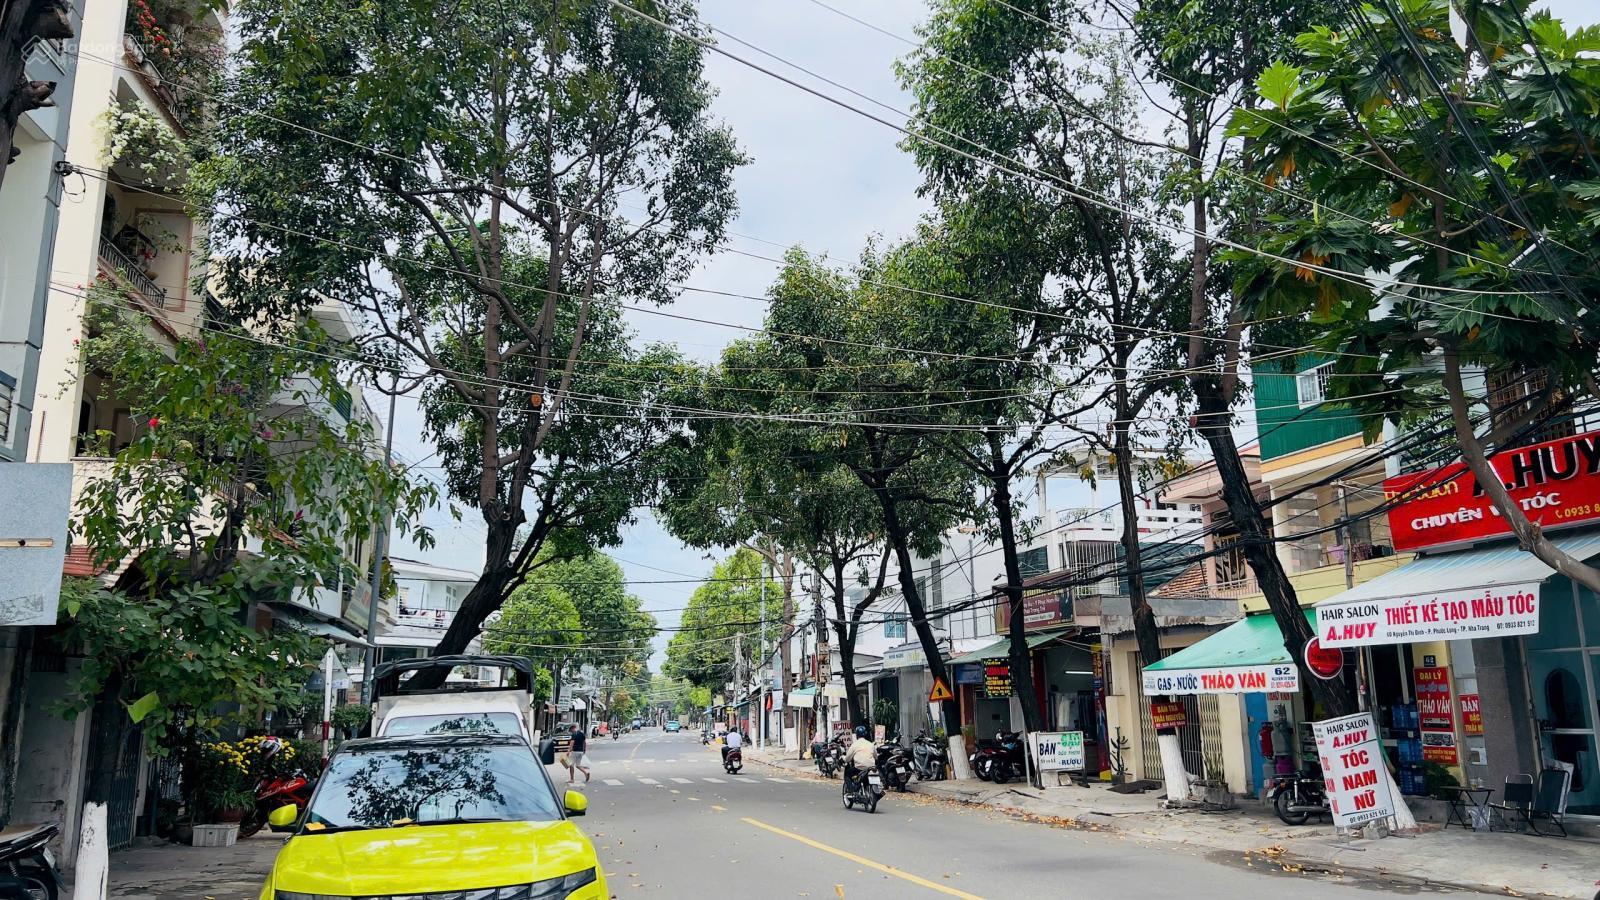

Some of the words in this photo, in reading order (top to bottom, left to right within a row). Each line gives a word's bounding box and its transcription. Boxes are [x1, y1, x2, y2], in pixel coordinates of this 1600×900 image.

[1411, 507, 1483, 530] CHUYÊN
[1519, 491, 1561, 511] TÓC
[1565, 505, 1591, 517] 0933
[1321, 608, 1344, 620] HAIR
[1346, 605, 1379, 619] SALON
[1385, 600, 1418, 625] THIẾT
[1421, 597, 1439, 622] KẾ
[1441, 600, 1468, 624] TẠO
[1471, 590, 1504, 618] MẪU
[1507, 590, 1535, 615] TÓC
[1326, 622, 1377, 641] A.HUY
[1157, 677, 1171, 691] GAS
[1201, 670, 1235, 689] THẢO
[1274, 667, 1290, 675] 62
[1326, 723, 1344, 735] HAIR
[1345, 719, 1369, 731] SALON
[1039, 740, 1056, 756] BÁN
[1333, 729, 1368, 748] A.HUY
[1340, 749, 1369, 769] TÓC
[1342, 769, 1378, 791] NAM
[1353, 789, 1375, 810] NỮ
